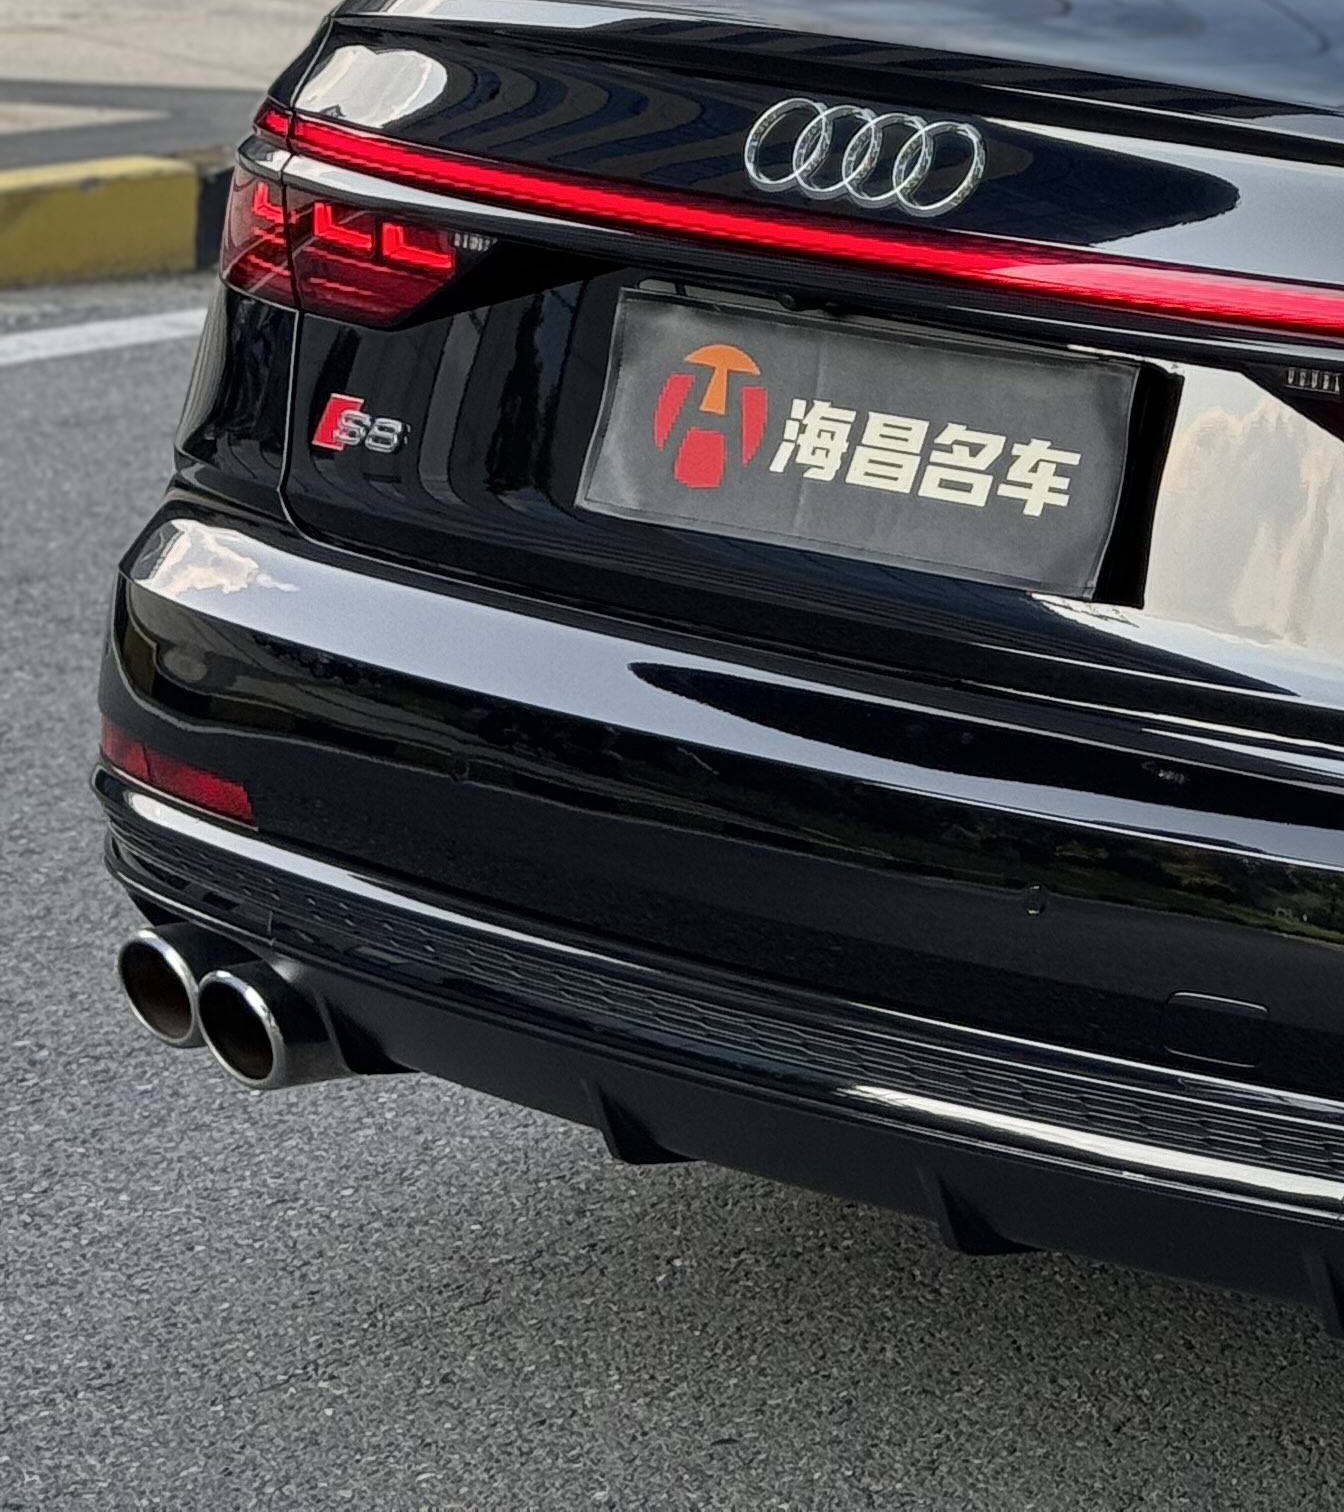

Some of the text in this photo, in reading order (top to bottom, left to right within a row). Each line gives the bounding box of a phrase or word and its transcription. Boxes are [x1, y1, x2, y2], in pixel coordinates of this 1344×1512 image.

[332, 408, 402, 453] S8
[769, 398, 1081, 517] 海昌名车
